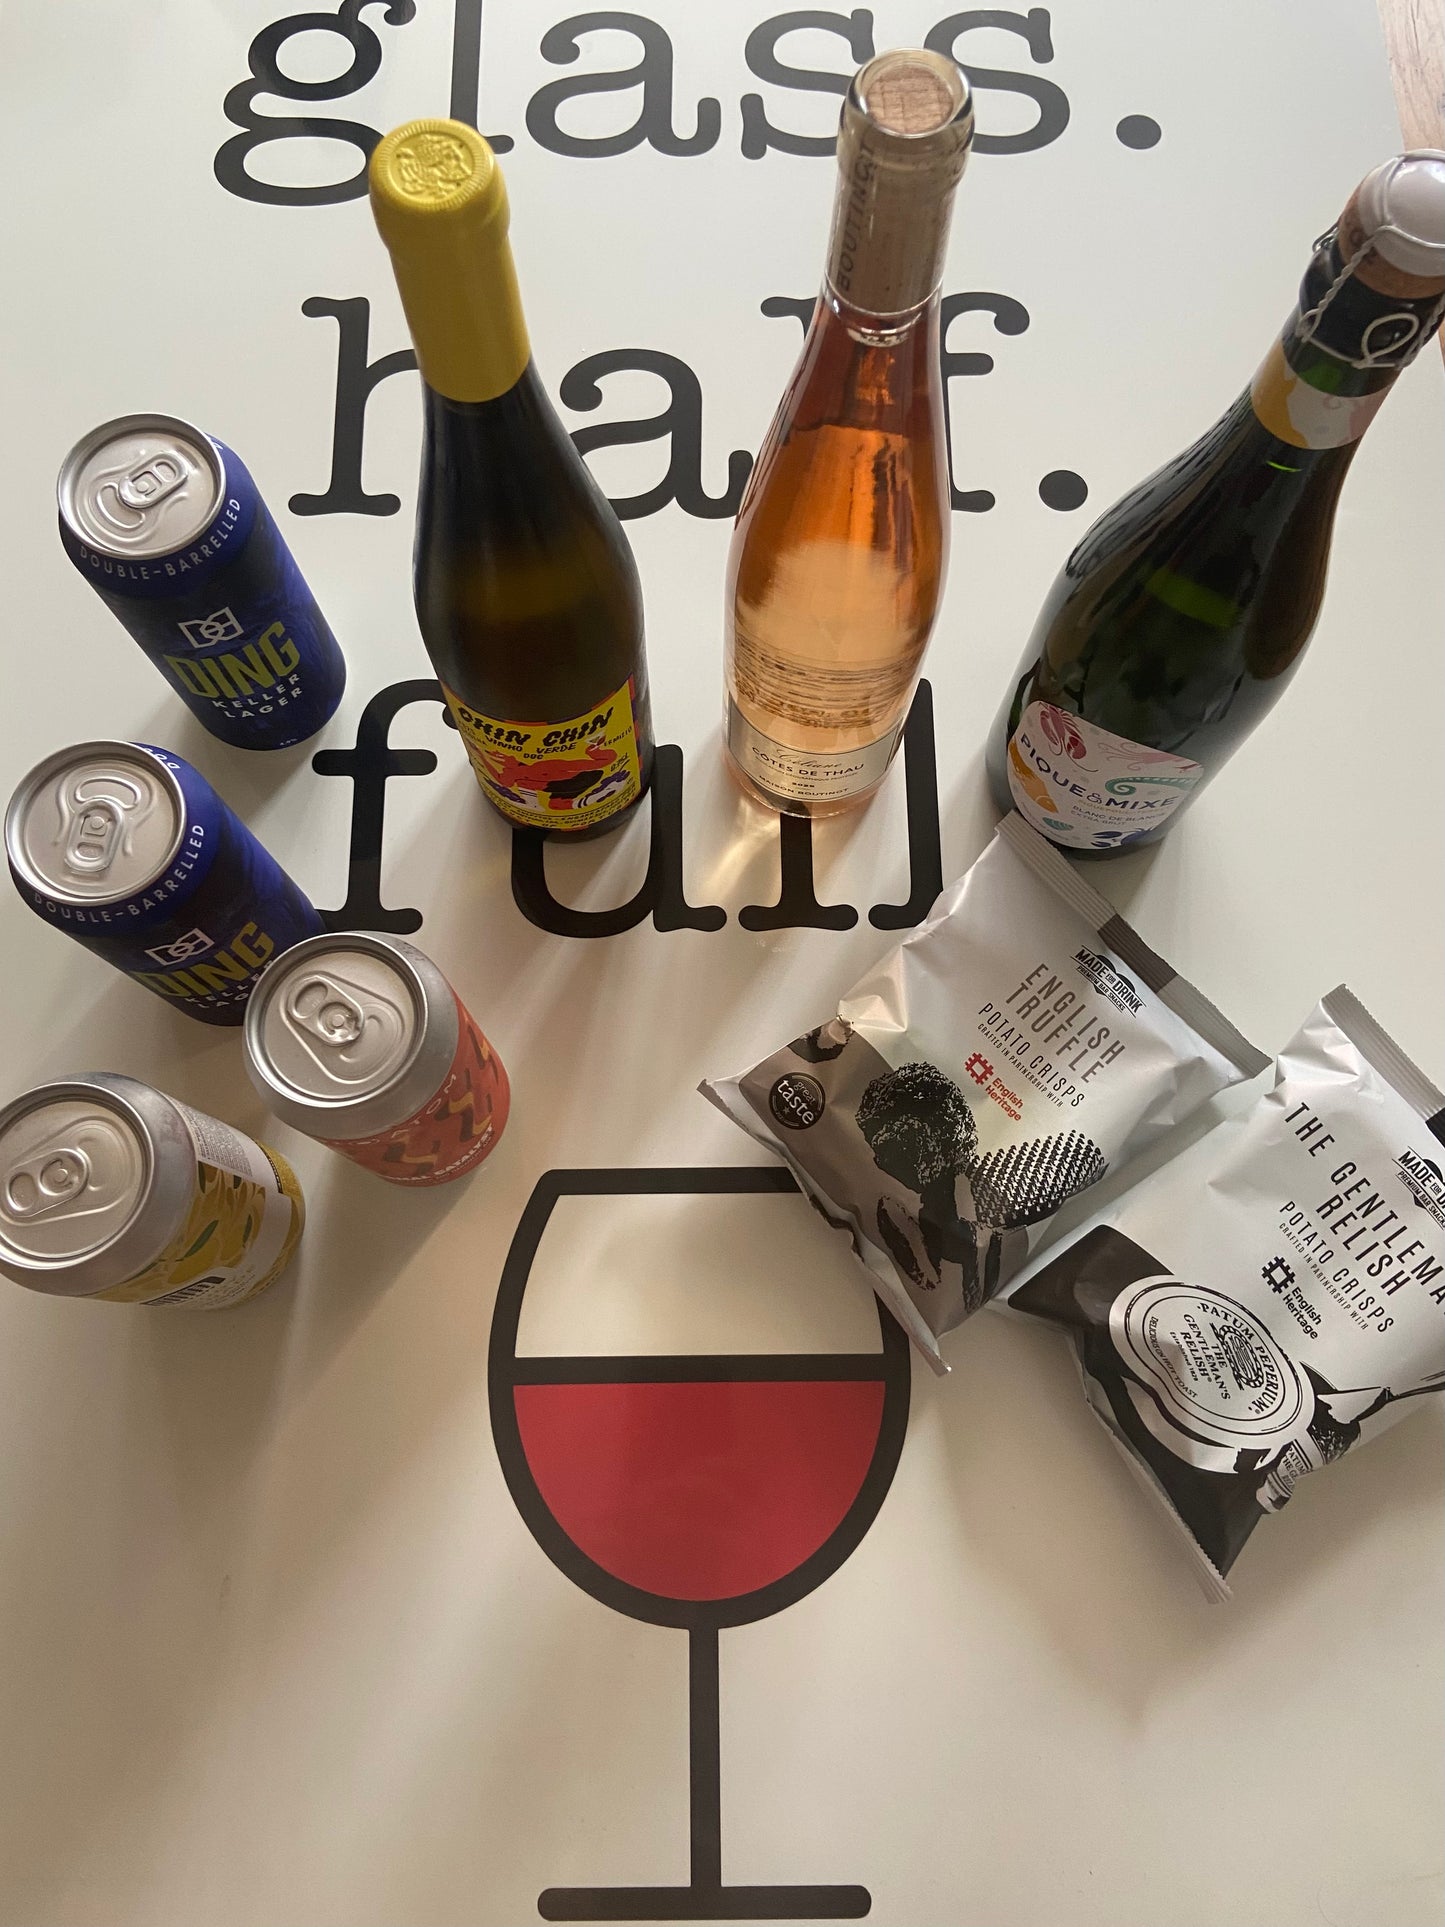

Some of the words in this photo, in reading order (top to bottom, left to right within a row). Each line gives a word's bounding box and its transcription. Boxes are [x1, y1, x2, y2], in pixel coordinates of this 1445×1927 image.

[214, 0, 1162, 207] glass.
[79, 497, 242, 580] DOUBLE-BARRELLED
[163, 621, 300, 699] DING
[212, 673, 300, 709] KELLER
[224, 687, 302, 719] LAGER
[458, 706, 531, 746] CHIN
[543, 706, 614, 747] CHIN
[485, 735, 523, 752] VINHO
[536, 742, 577, 755] VERDE
[759, 775, 795, 794] MAISON
[799, 769, 818, 777] DE
[824, 763, 865, 777] THAU
[1072, 805, 1106, 819] BLANC
[33, 823, 205, 923] DOUBLE-BARRELLED
[131, 921, 275, 998] DING
[1075, 949, 1107, 979] MADE
[1105, 972, 1117, 986] FOR
[1112, 978, 1145, 1014] DRINK
[198, 992, 250, 1009] LAG
[1076, 965, 1099, 987] PREMIUM
[1098, 982, 1110, 995] BAR
[1107, 991, 1126, 1012] SNACKS
[1005, 982, 1105, 1084] TRUFFLE
[1024, 963, 1126, 1065] ENGLISH
[977, 1023, 1002, 1050] CRAFTED
[1000, 1046, 1011, 1058] IN
[1008, 1054, 1048, 1096] PARTNERSHIP
[1046, 1089, 1065, 1109] WITH
[978, 1002, 1032, 1056] POTATO
[1029, 1055, 1086, 1109] CRISPS
[777, 1079, 816, 1125] taste
[793, 1081, 817, 1105] great
[985, 1083, 1022, 1122] Heritage
[992, 1077, 1025, 1110] English
[1397, 1150, 1435, 1188] MADE
[1430, 1183, 1442, 1196] FOR
[1397, 1171, 1422, 1196] PREMIUM
[1419, 1192, 1432, 1207] BAR
[1284, 1101, 1335, 1157] THE
[1330, 1161, 1445, 1311] GENTLEMA
[1279, 1201, 1334, 1264] POTATO
[1332, 1267, 1395, 1333] CRISPS
[1315, 1193, 1411, 1297] RELISH
[1278, 1222, 1304, 1253] CRAFTED
[1303, 1253, 1313, 1264] IN
[1310, 1263, 1351, 1310] PARTNERSHIP
[1349, 1309, 1369, 1330] WITH
[1199, 1302, 1255, 1341] PATUM
[1282, 1293, 1319, 1340] Heritage
[1291, 1286, 1322, 1325] English
[1162, 1357, 1177, 1375] HOT
[1174, 1374, 1199, 1399] TOAST
[1183, 1314, 1231, 1400] GENTLEMAN'S
[1211, 1343, 1228, 1368] THE
